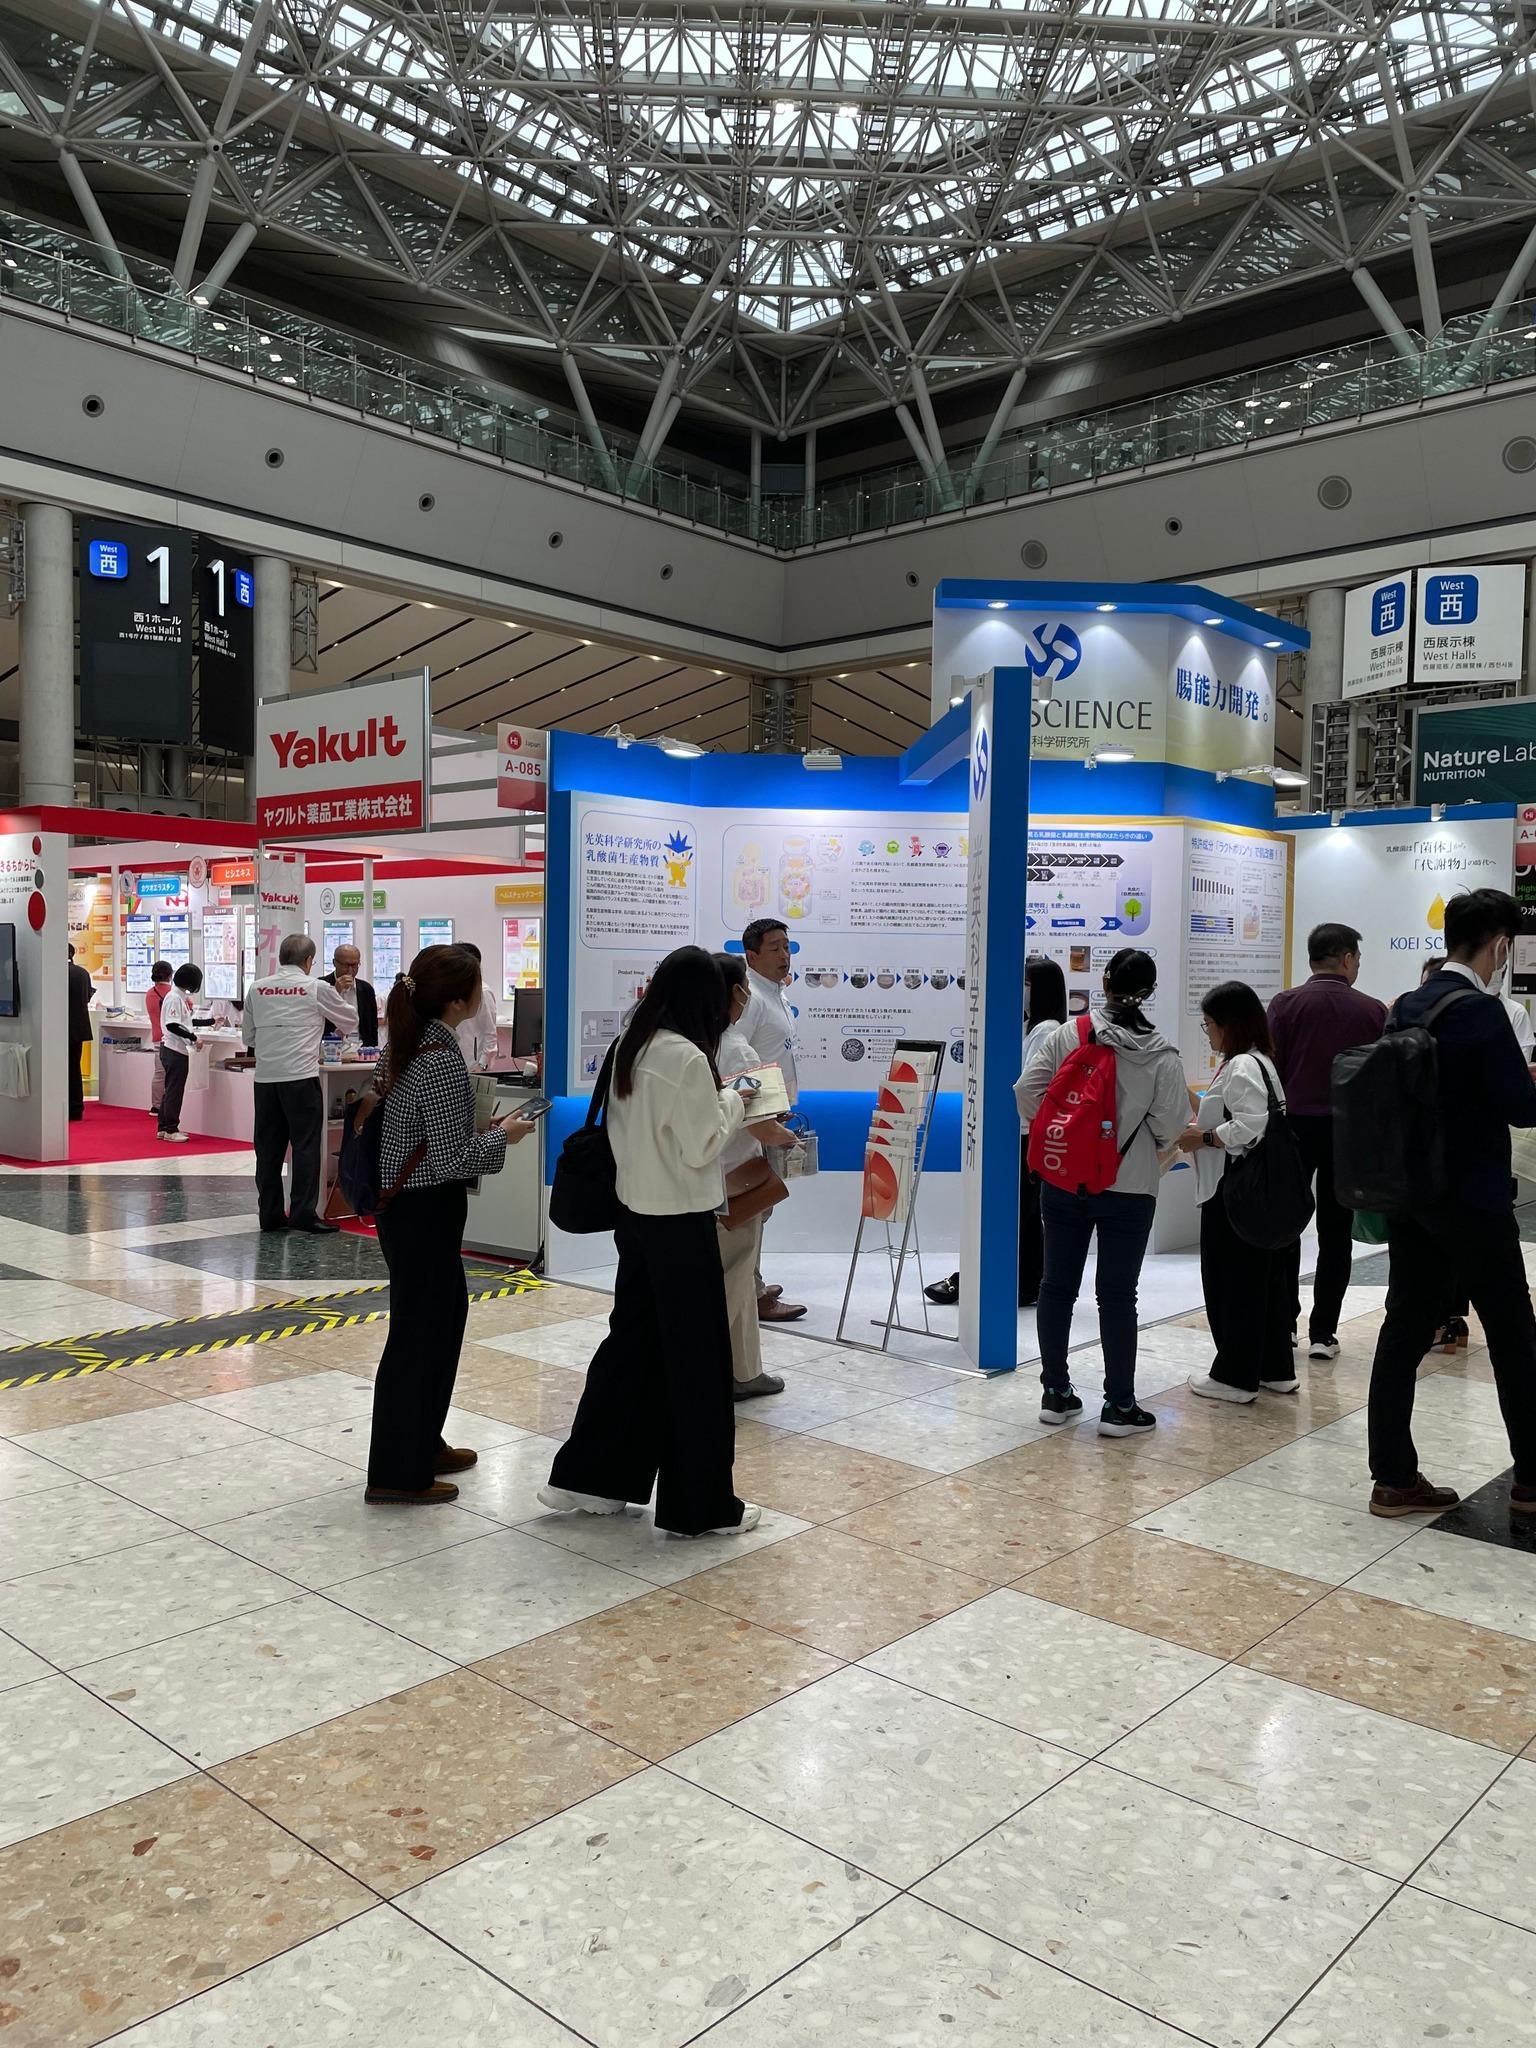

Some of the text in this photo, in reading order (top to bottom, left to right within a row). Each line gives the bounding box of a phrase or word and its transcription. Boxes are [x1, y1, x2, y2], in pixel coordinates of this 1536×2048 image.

[100, 545, 117, 553] West
[100, 554, 117, 575] 西
[147, 546, 169, 604] 1
[210, 559, 225, 617] 1
[240, 583, 249, 603] 西
[1440, 580, 1464, 590] West
[1380, 589, 1397, 602] West
[1440, 594, 1463, 620] 西
[133, 612, 182, 625] 西1ホール
[1380, 602, 1395, 631] 西
[135, 624, 181, 636] West Hall 1
[204, 621, 229, 638] 西1ホール
[1370, 640, 1403, 660] 西展示棟
[1423, 636, 1475, 649] 西展示棟
[1423, 650, 1476, 661] West Halls
[1369, 656, 1403, 672] West Halls
[269, 715, 407, 769] Yakult
[505, 760, 541, 776] A-085
[1423, 768, 1486, 782] NUTRITION
[264, 793, 413, 828] ヤクルト薬品工業株式会社
[585, 832, 662, 851] 光英科学研究所の
[1521, 830, 1536, 839] A-
[586, 849, 660, 868] 乳酸菌生産物質
[225, 868, 251, 880] ヒシエキス
[261, 892, 300, 905] Yakult
[1390, 937, 1420, 950] KOEI
[257, 986, 308, 997] Yakult
